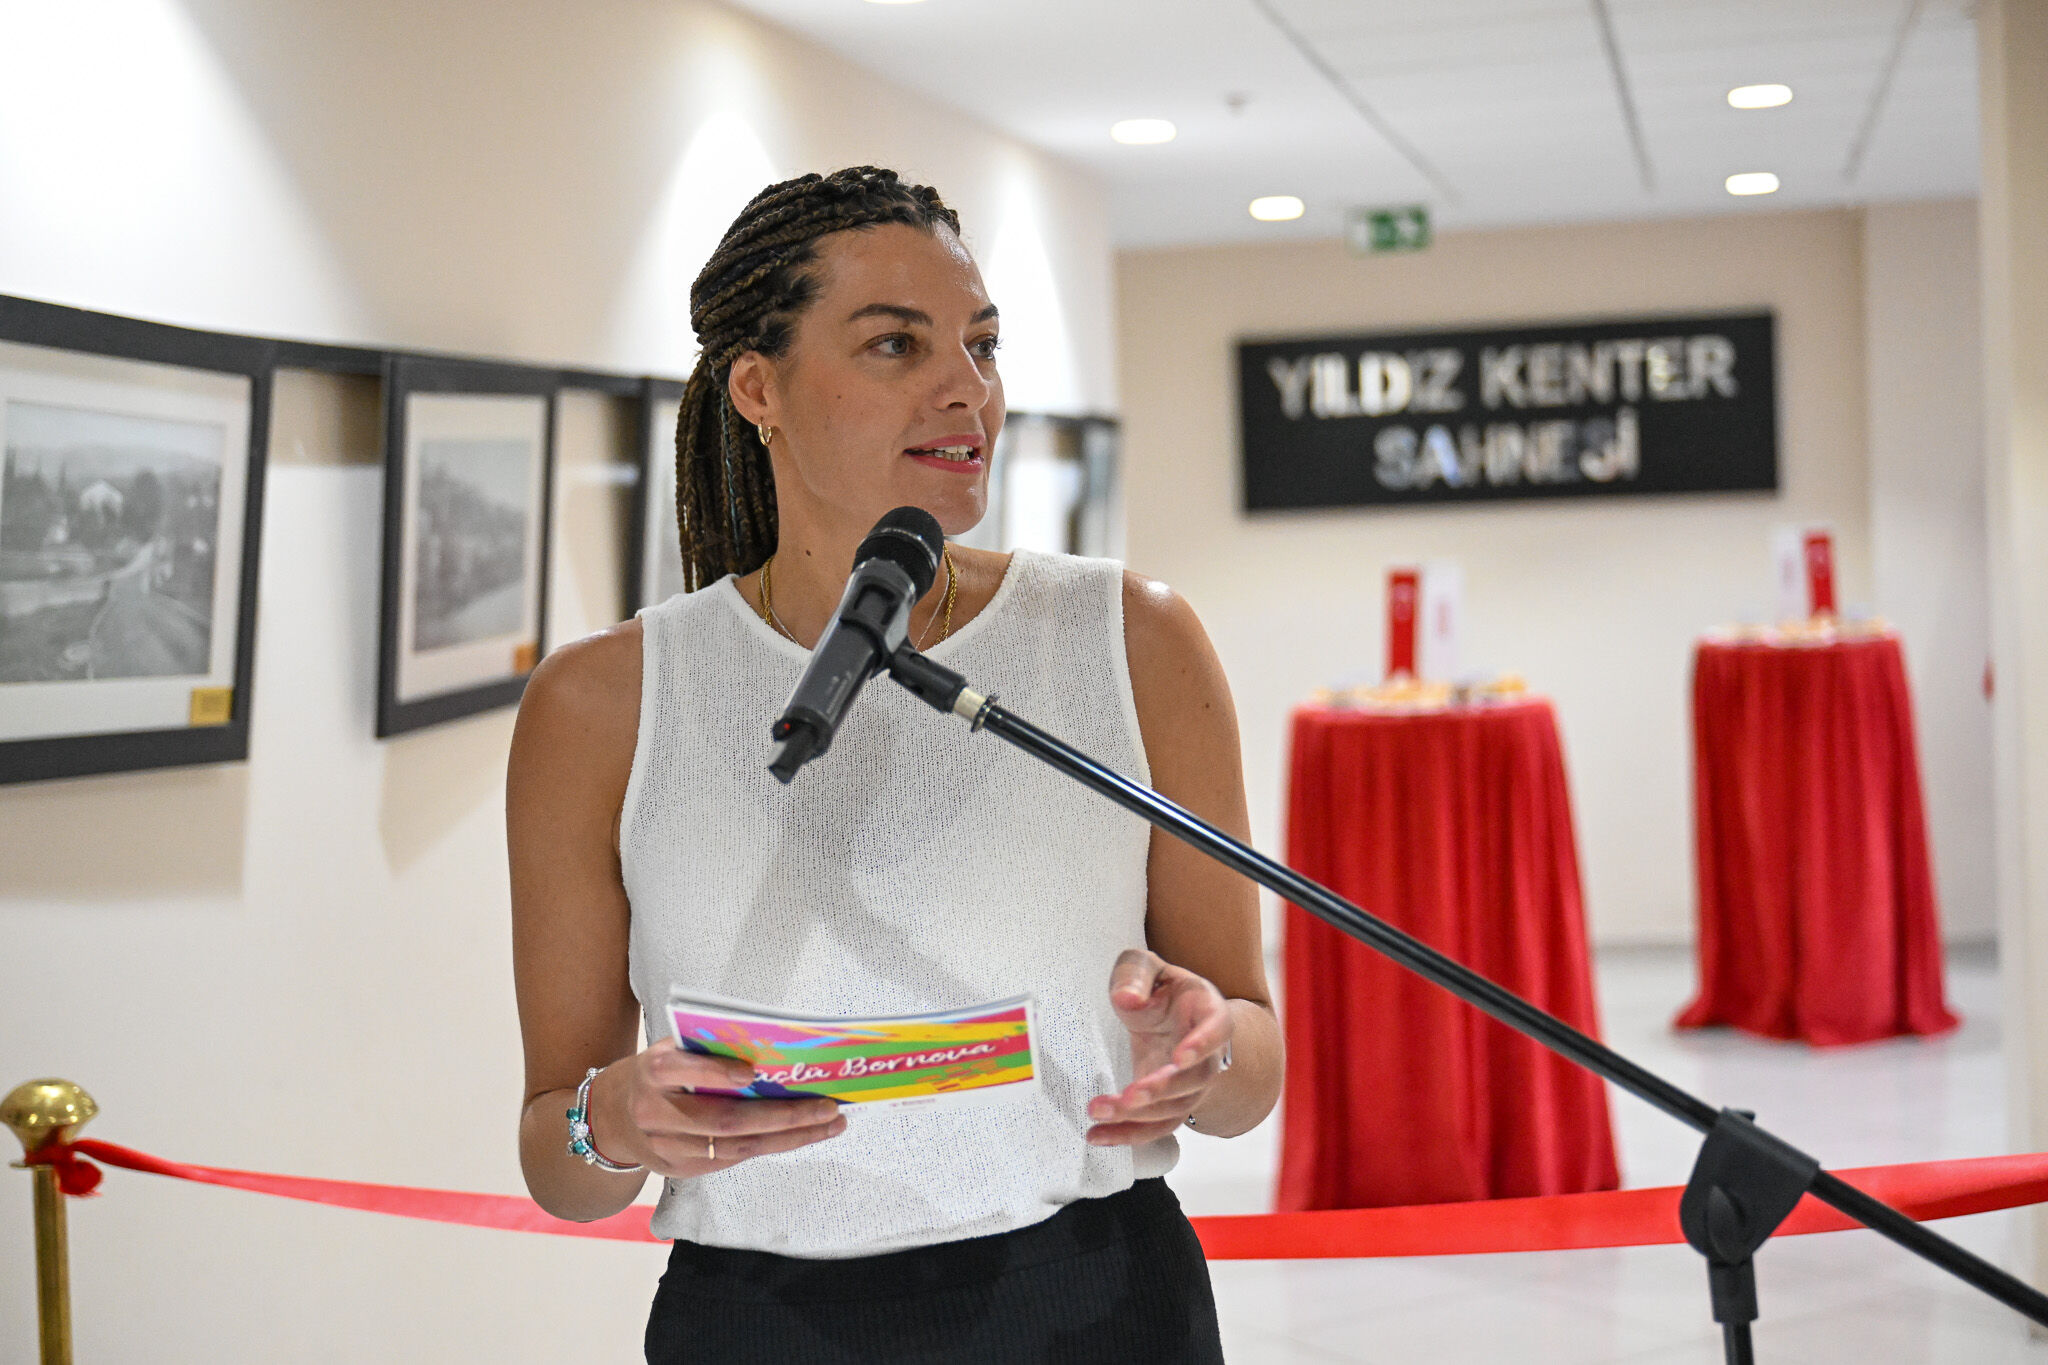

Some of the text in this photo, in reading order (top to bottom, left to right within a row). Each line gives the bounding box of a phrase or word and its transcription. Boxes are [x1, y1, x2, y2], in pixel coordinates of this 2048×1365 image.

[1269, 335, 1738, 420] YILDIZ KENTER
[838, 1044, 996, 1076] Bornova
